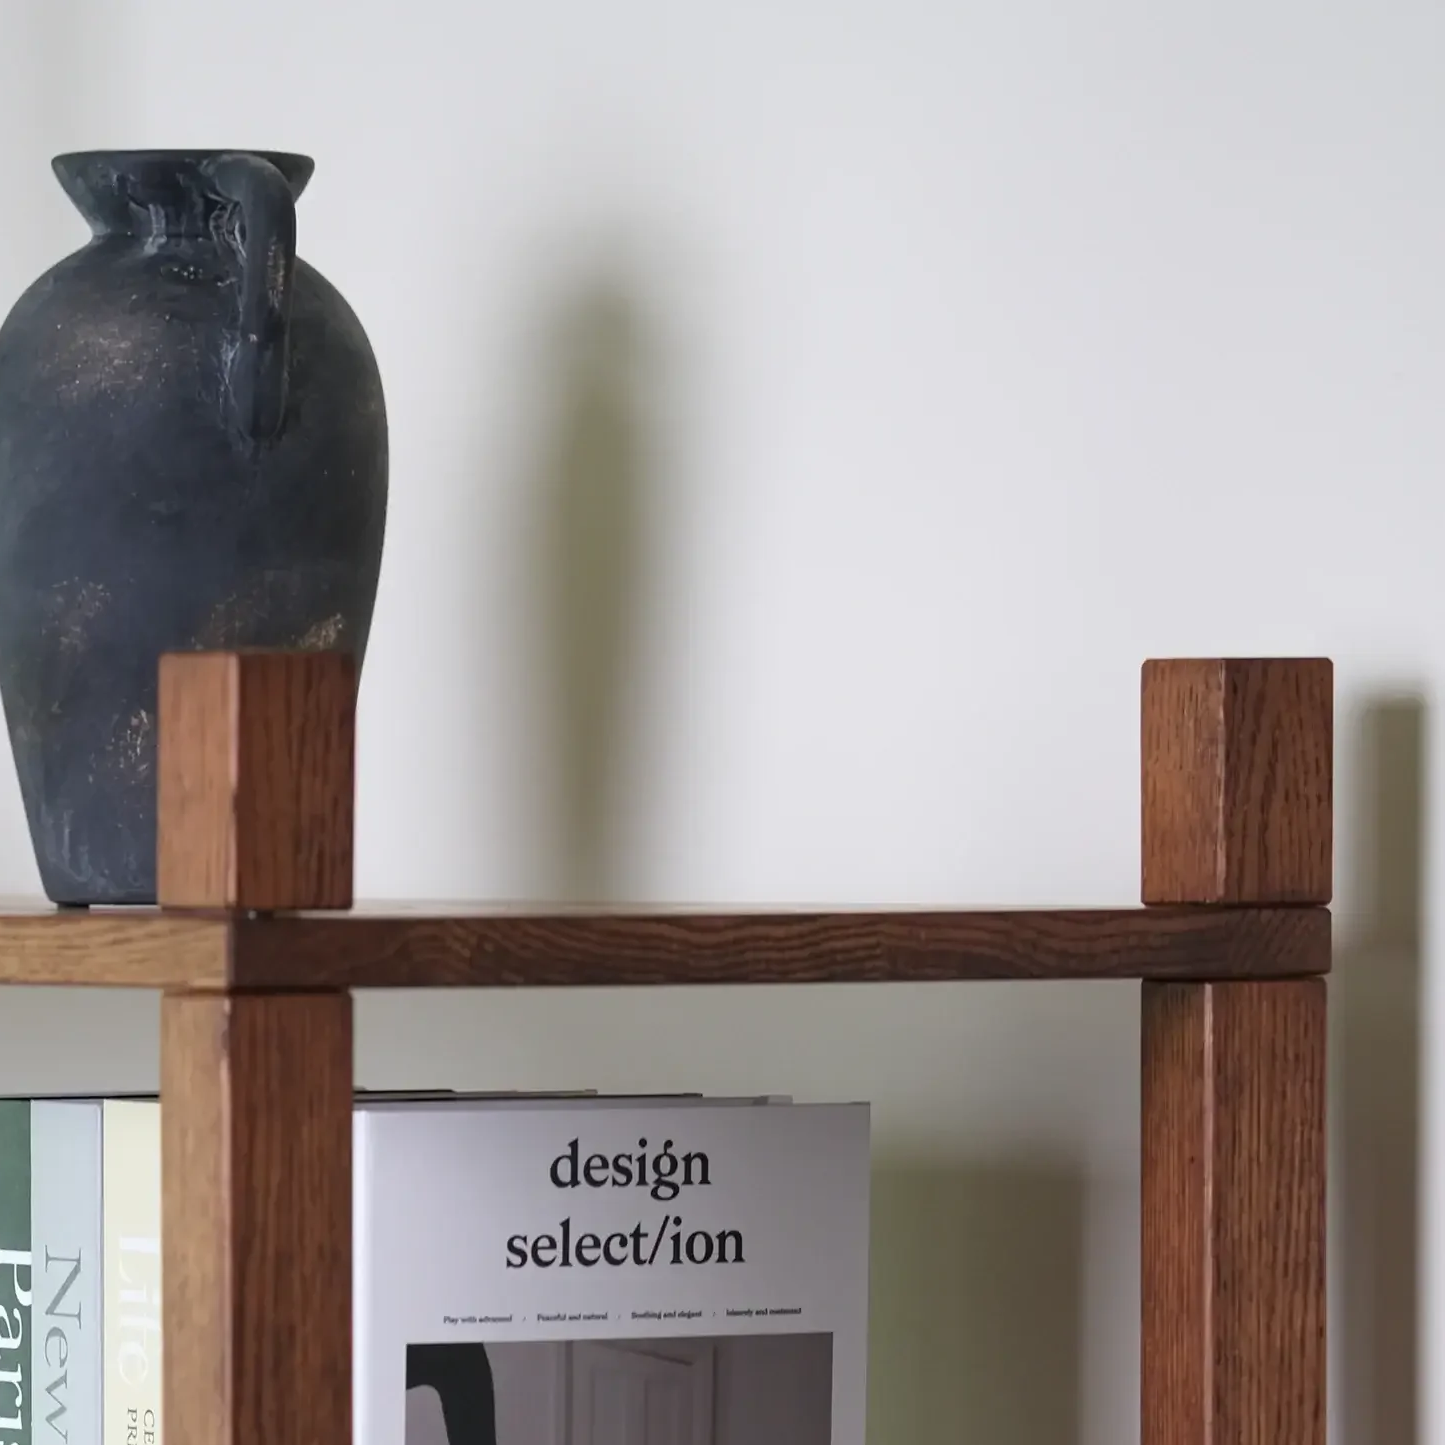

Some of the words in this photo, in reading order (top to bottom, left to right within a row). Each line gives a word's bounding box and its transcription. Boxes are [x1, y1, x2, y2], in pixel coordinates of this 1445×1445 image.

[549, 1136, 713, 1202] design
[505, 1213, 746, 1269] select/ion
[568, 1312, 581, 1321] and
[663, 1309, 676, 1319] and
[755, 1307, 768, 1317] and
[44, 1244, 83, 1444] New
